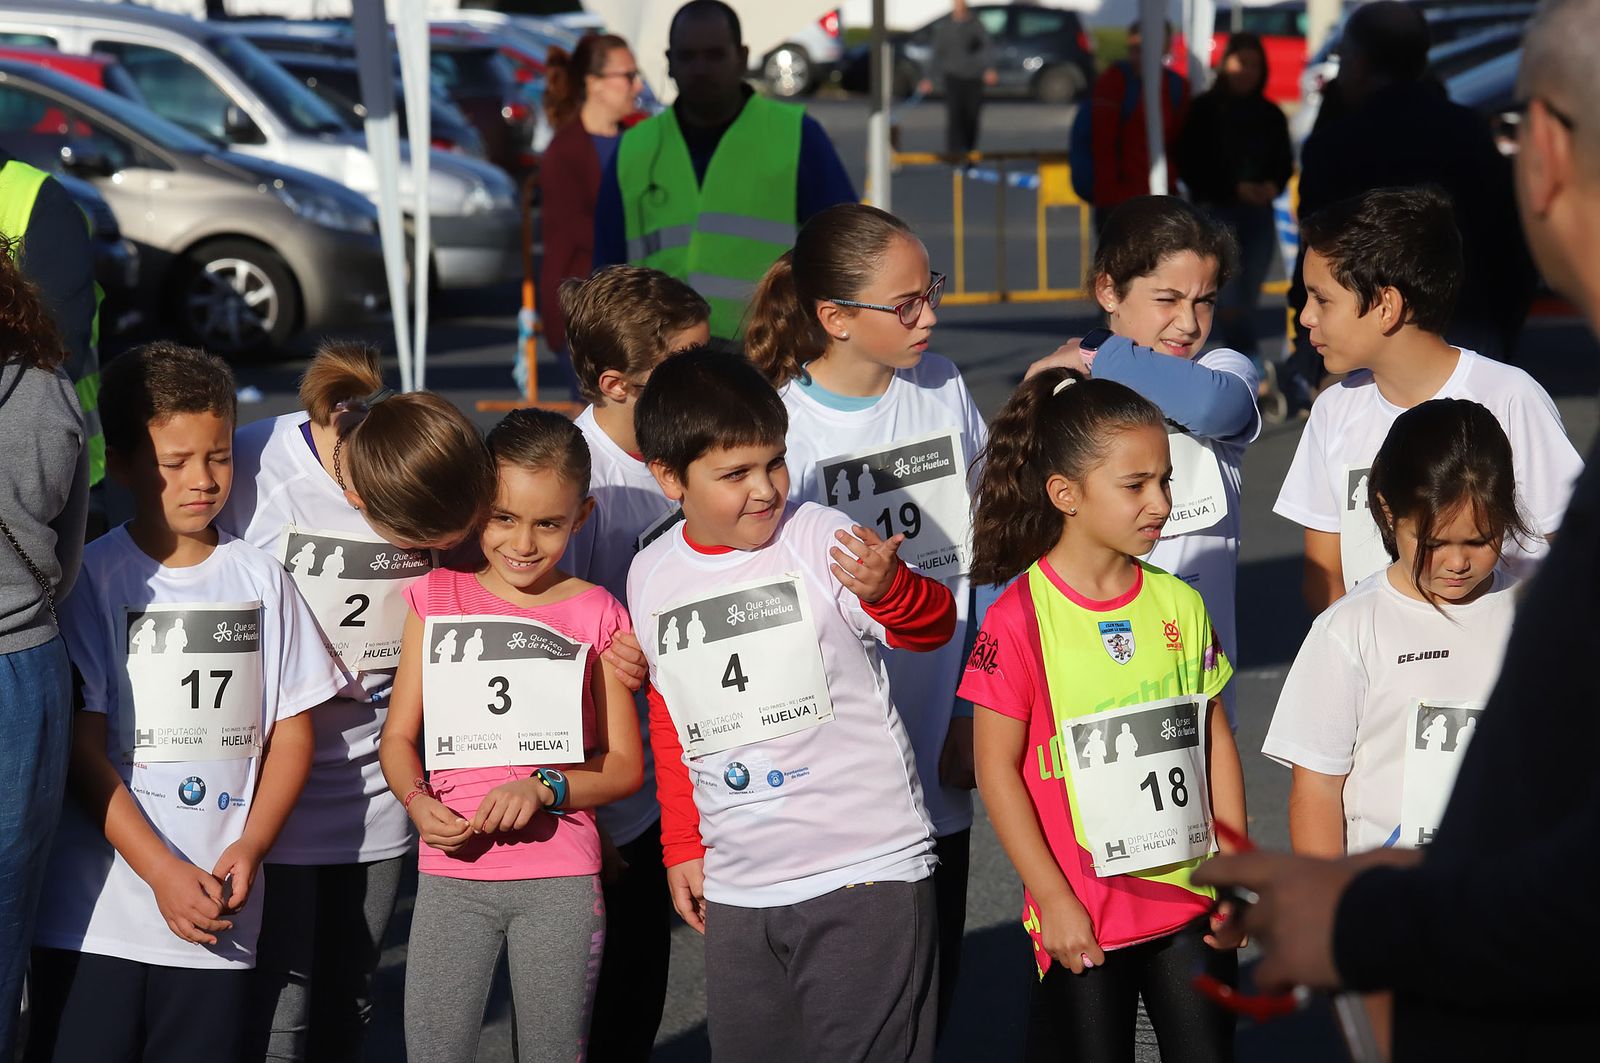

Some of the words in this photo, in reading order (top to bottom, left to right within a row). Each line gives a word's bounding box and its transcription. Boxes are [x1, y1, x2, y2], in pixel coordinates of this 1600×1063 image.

[910, 456, 925, 465] Que
[927, 451, 938, 461] sea
[912, 465, 921, 473] de
[923, 458, 949, 471] Huelva
[876, 502, 921, 539] 19
[393, 553, 409, 561] Que
[410, 552, 422, 560] sea
[402, 558, 429, 569] Huelva
[918, 553, 959, 570] HUELVA
[340, 594, 370, 627] 2
[746, 600, 763, 612] Que
[765, 597, 781, 607] sea
[748, 611, 759, 621] de
[760, 604, 793, 618] Huelva
[234, 622, 247, 632] Que
[247, 623, 256, 631] sea
[243, 632, 259, 641] Huelva
[530, 634, 547, 643] Que
[548, 641, 563, 651] sea
[977, 631, 999, 650] OLA
[540, 644, 571, 656] Huelva
[1398, 650, 1449, 664] CEJUDO
[721, 653, 749, 692] 4
[181, 669, 233, 709] 17
[487, 676, 512, 715] 3
[700, 712, 744, 728] DIPUTACIÓN
[762, 705, 811, 726] HUELVA
[158, 727, 208, 736] DIPUTACIÓN
[702, 728, 712, 737] DE
[712, 722, 741, 734] HUELVA
[172, 736, 203, 744] HUELVA
[222, 734, 252, 746] HUELVA
[456, 733, 502, 742] DIPUTACIÓN
[519, 740, 563, 751] HUELVA
[1140, 767, 1188, 811] 18
[1127, 828, 1178, 845] DIPUTACIÓN
[1129, 845, 1141, 854] DE
[1143, 838, 1176, 851] HUELVA
